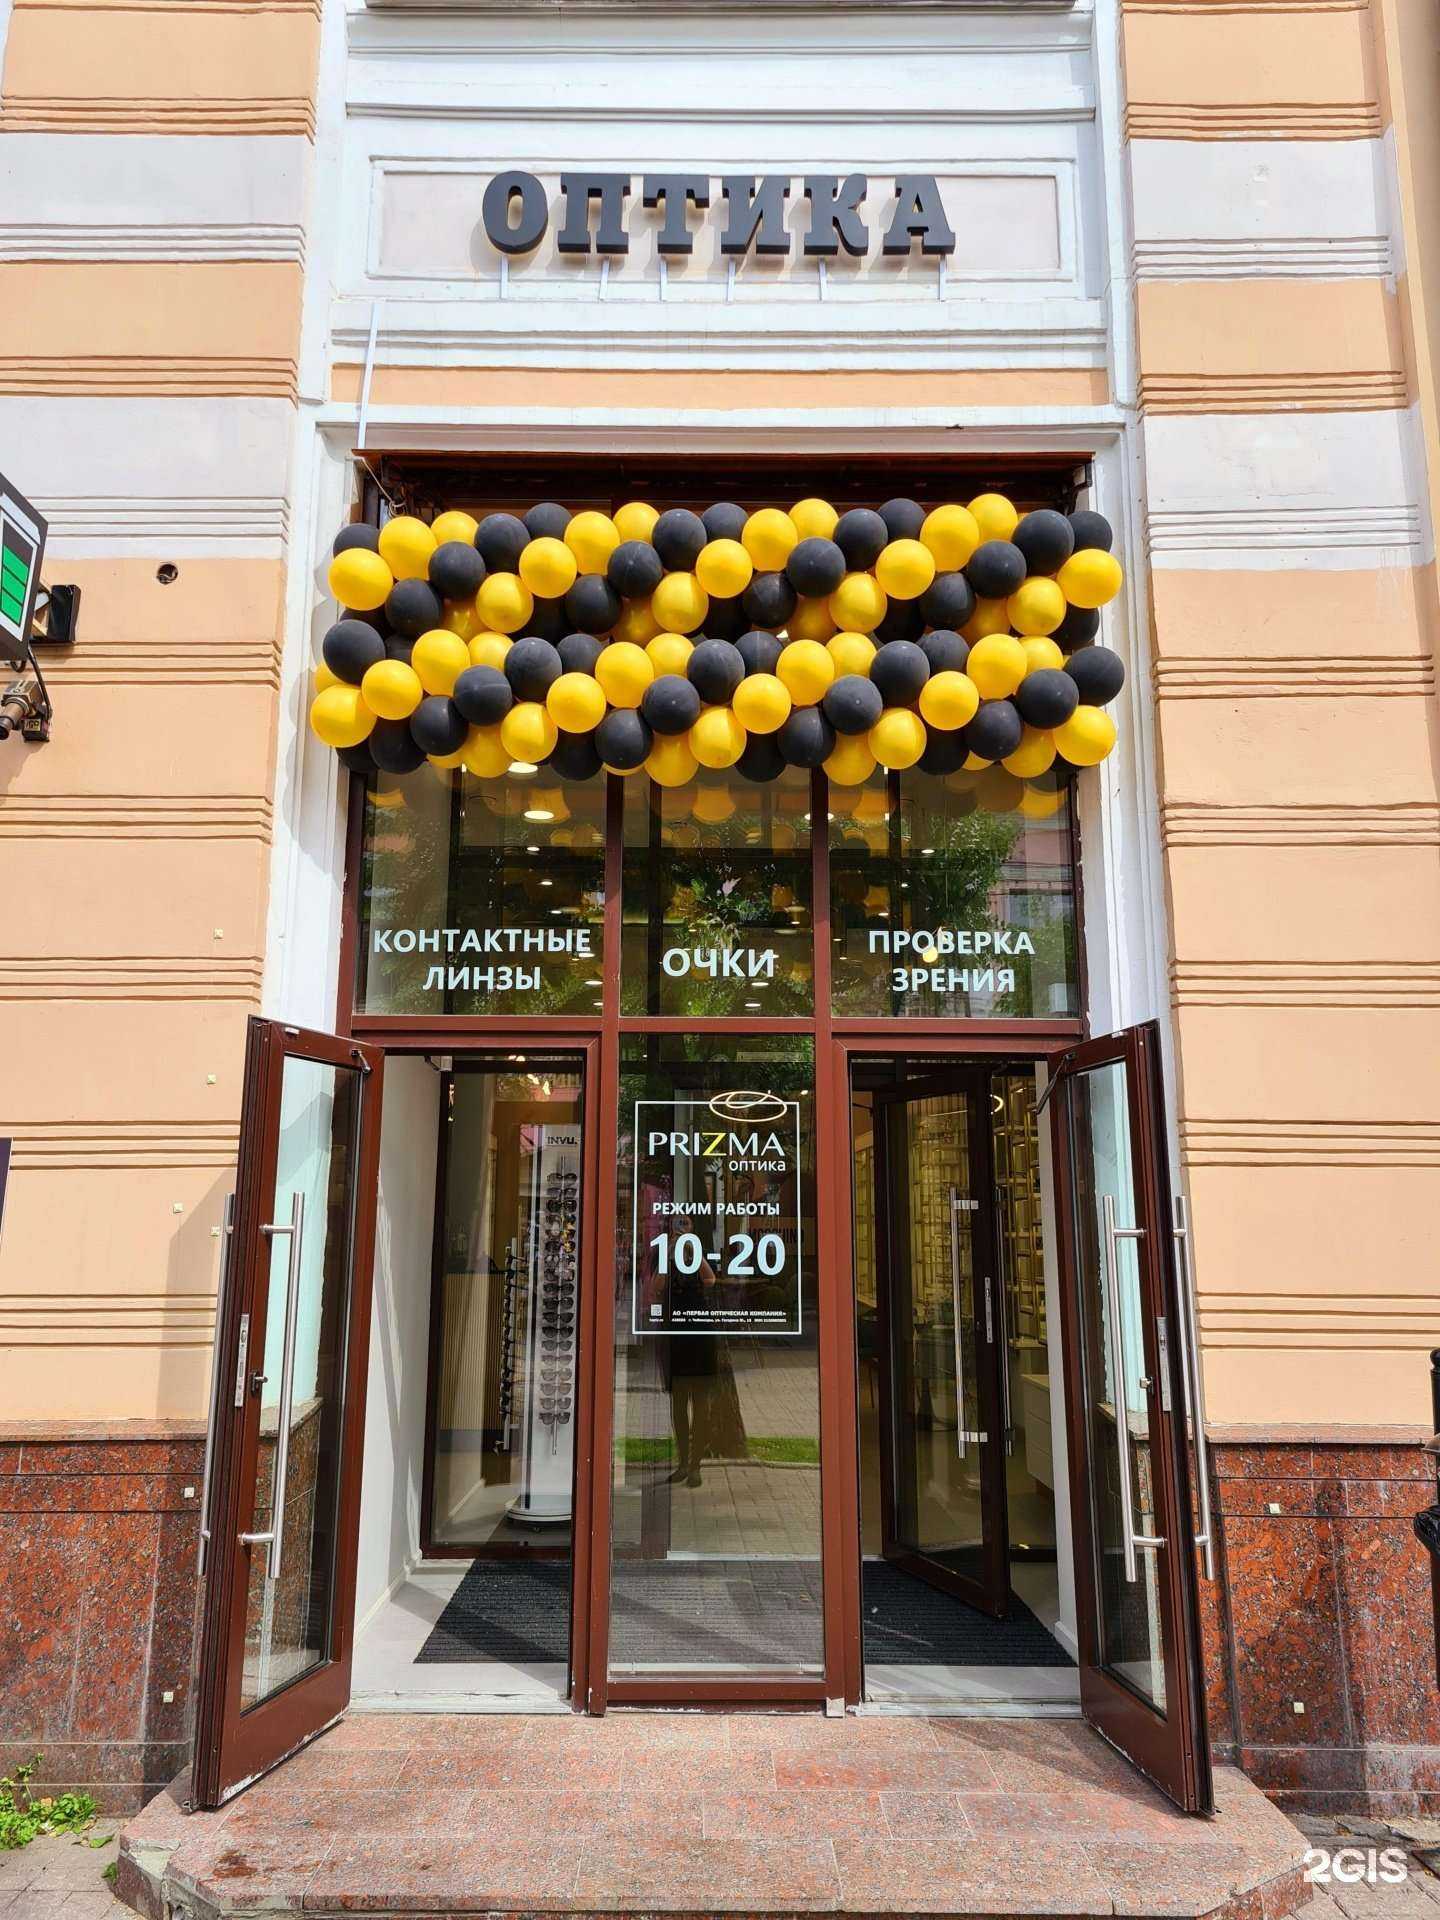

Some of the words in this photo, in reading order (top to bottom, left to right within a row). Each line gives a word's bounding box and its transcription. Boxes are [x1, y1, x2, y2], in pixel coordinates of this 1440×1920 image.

[482, 171, 956, 256] ОПТИКА
[373, 928, 592, 954] КОНТАКТНЫЕ
[868, 930, 1036, 955] ПРОВЕРКА
[662, 948, 776, 978] ОЧКИ
[422, 966, 541, 990] ЛИНЗЫ
[892, 967, 1015, 993] ЗРЕНИЯ
[648, 1132, 785, 1156] PRIZMA
[729, 1160, 786, 1172] оптика
[653, 1202, 711, 1215] РЕЖИМ
[716, 1202, 780, 1216] РАБОТЫ
[650, 1233, 786, 1275] 10-20
